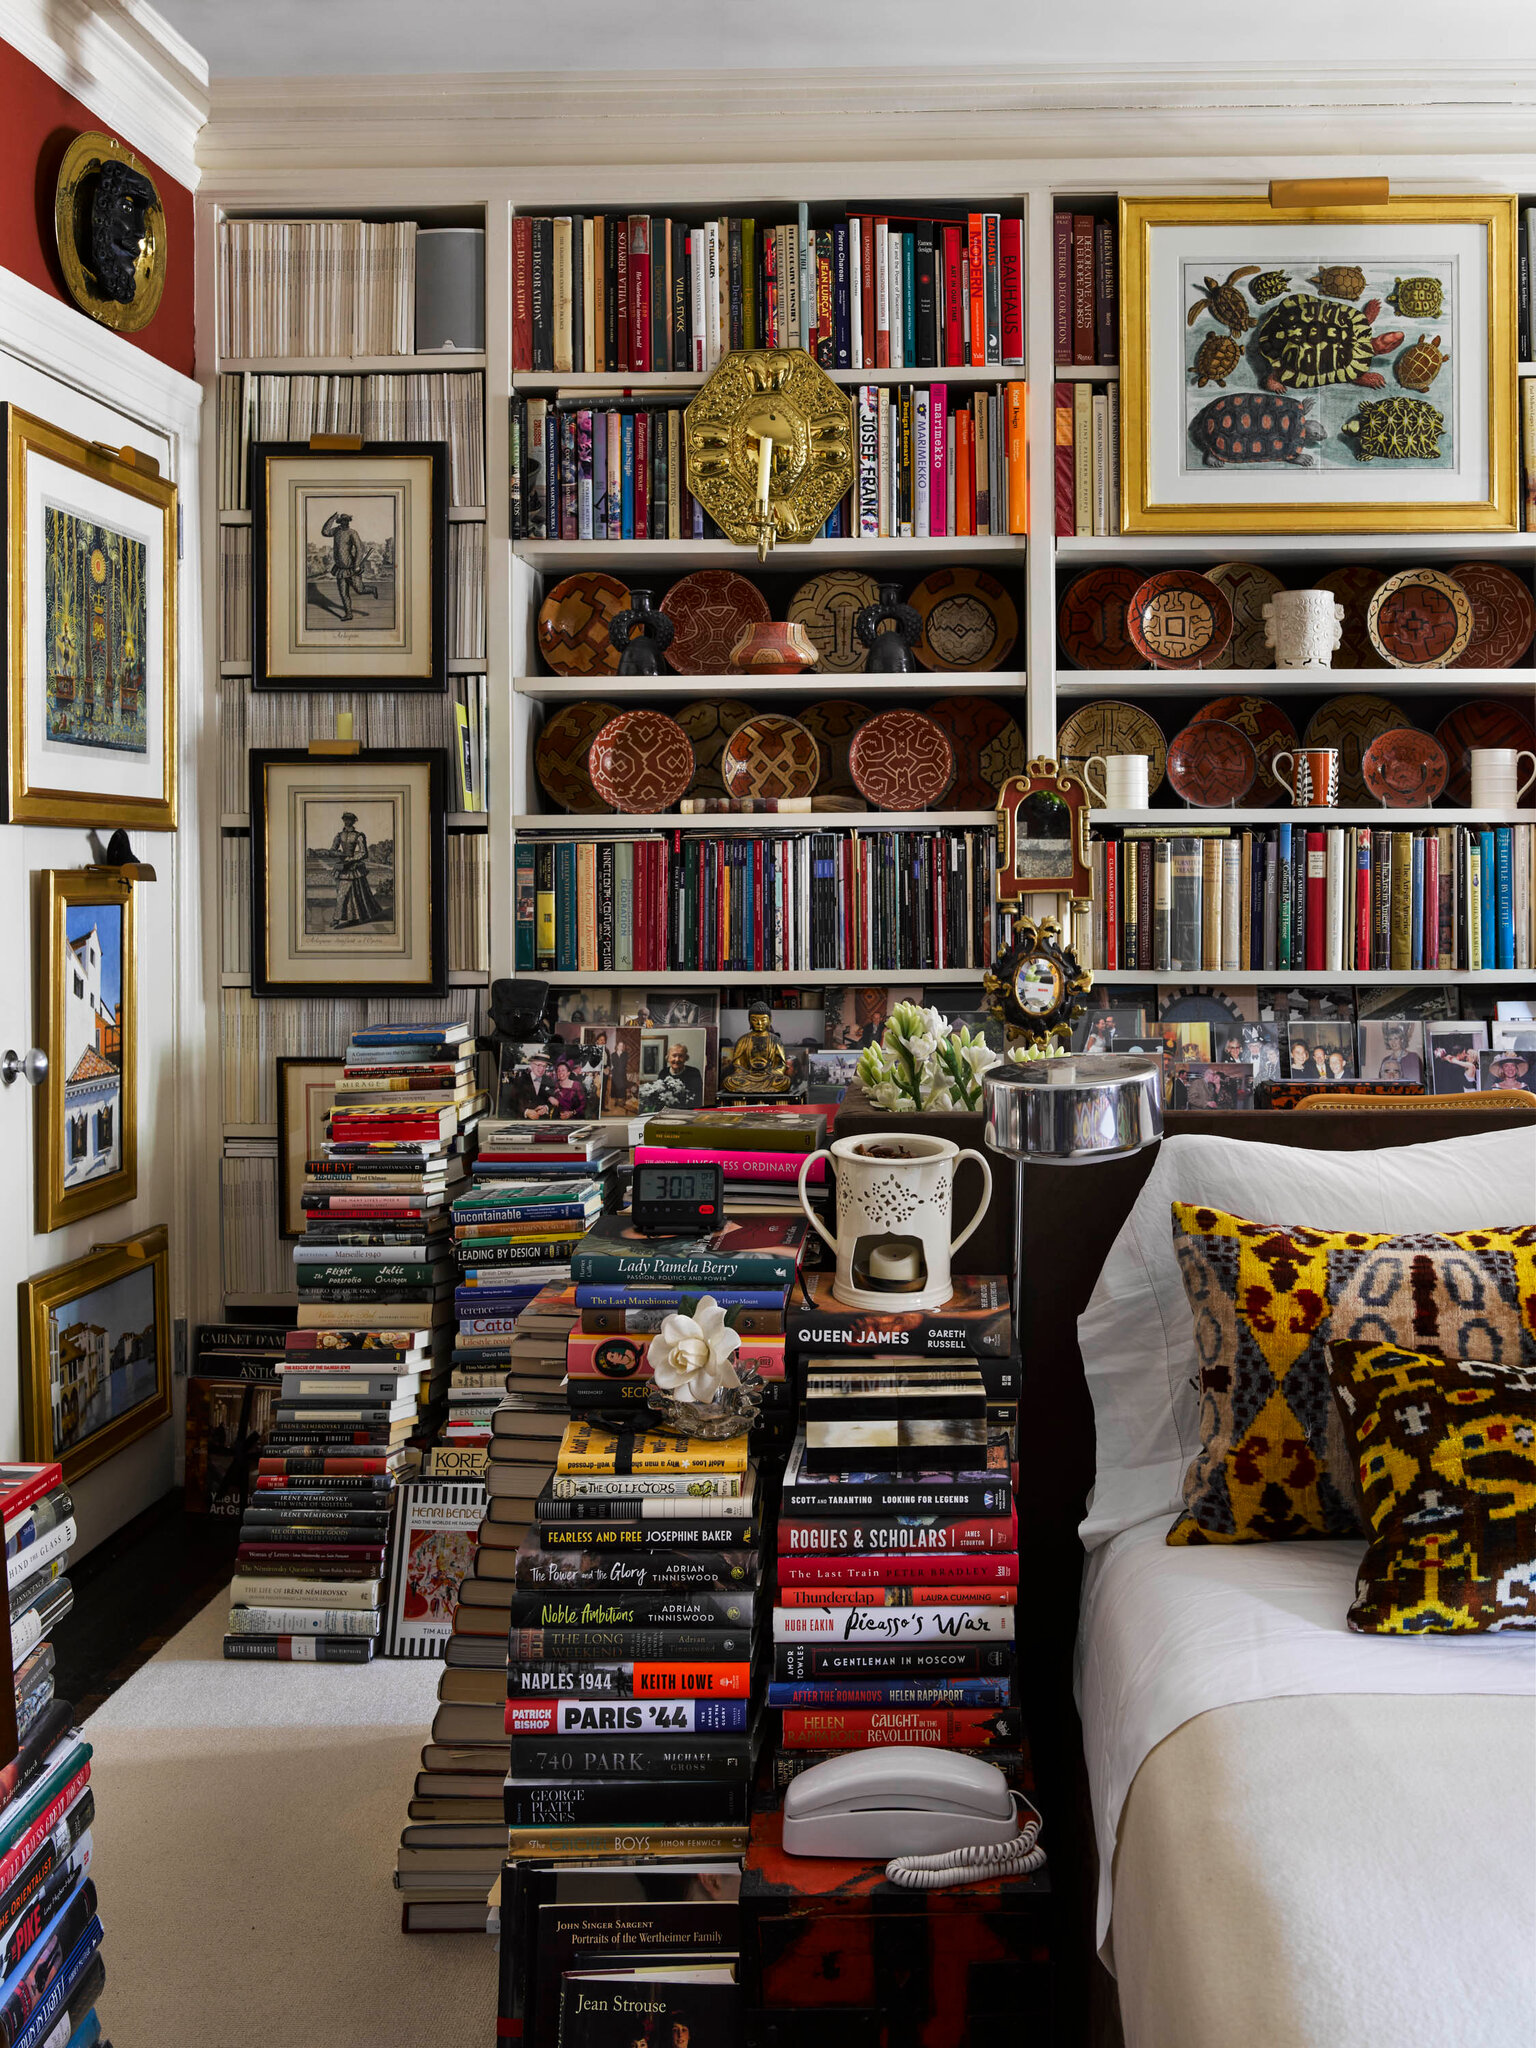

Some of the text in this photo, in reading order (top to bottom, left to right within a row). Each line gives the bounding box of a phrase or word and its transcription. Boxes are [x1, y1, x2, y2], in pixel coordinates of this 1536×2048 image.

[987, 217, 996, 266] BAUHAUS
[821, 261, 829, 283] JEAN
[517, 250, 526, 319] DECORATION
[618, 277, 626, 304] VILLA
[675, 277, 684, 303] VILLA
[1058, 233, 1067, 344] INTERIOR DECORATION
[1003, 255, 1018, 335] BAUHAUS
[619, 305, 627, 318] LA
[902, 401, 911, 467] Design Research
[934, 402, 943, 468] marimekko
[918, 420, 927, 489] MARIMEKKO
[861, 415, 876, 517] JOSEF FRANK
[1501, 849, 1509, 928] LITTLE BY LITTLE
[309, 1163, 354, 1172] THE EYE
[742, 1161, 798, 1172] ORDINARY
[454, 1209, 522, 1222] Uncontainable
[335, 1250, 382, 1259] Marseille 1940
[458, 1247, 541, 1261] LEADING BY DESIGN
[325, 1265, 404, 1276] Flight Julie
[618, 1259, 738, 1276] Lady Pamela Berry
[627, 1274, 655, 1282] PASSION,
[591, 1296, 678, 1305] The Last Marchioness
[460, 1305, 495, 1316] terence
[200, 1333, 252, 1345] CABINET
[798, 1328, 910, 1345] QUEEN JAMES
[928, 1329, 966, 1339] GARETH
[927, 1339, 966, 1349] RUSSELL
[588, 1481, 675, 1494] THE COLLECTORS
[791, 1495, 969, 1505] SCOTT TARANTINO LOOKING FOR LEGENDS
[411, 1507, 484, 1520] HENRI BENDEL
[548, 1530, 732, 1543] FEARLESS AND FREE JOSEPHINE BAKER
[790, 1529, 947, 1549] ROGUES & SCHOLARS
[964, 1530, 981, 1538] JAMES
[40, 1536, 62, 1558] GLASS
[530, 1562, 647, 1586] The Power Glory
[666, 1565, 704, 1573] ADRIAN
[789, 1567, 988, 1579] The Last Train PETER BRADLEY
[652, 1573, 718, 1582] TINNISWOOD
[793, 1591, 992, 1606] Thunderclap LAURA CUMMING
[541, 1603, 634, 1626] Noble Ambitions
[662, 1605, 700, 1613] ADRIAN
[648, 1614, 715, 1623] TINNISWOOD
[784, 1619, 808, 1632] HUGH
[809, 1619, 834, 1632] EAKIN
[932, 1613, 992, 1637] War
[552, 1633, 580, 1645] THE
[584, 1633, 624, 1645] LONG
[552, 1646, 623, 1658] WEEKEND
[822, 1655, 966, 1667] A GENTLEMAN IN MOSCOW
[521, 1672, 714, 1691] NAPLES 1944 KEITH LOWE
[793, 1690, 964, 1702] AFTER THE ROMANOVS HELEN RAPPAPORT
[512, 1709, 552, 1720] PATRICK
[564, 1706, 643, 1730] PARIS
[871, 1713, 920, 1728] CAUGHT
[514, 1720, 550, 1730] BISHOP
[804, 1716, 845, 1729] HELEN
[787, 1730, 865, 1742] RAPPAPORT
[867, 1729, 941, 1742] REVOLUTION
[537, 1752, 644, 1771] 740 PARK
[664, 1752, 713, 1762] MICHAEL
[670, 1763, 706, 1771] GROSS
[530, 1789, 585, 1801] GEORGE
[531, 1801, 575, 1813] PLATT
[531, 1812, 576, 1823] LYNES
[529, 1840, 546, 1850] The
[614, 1836, 650, 1851] BOYS
[660, 1840, 686, 1848] SIMON
[688, 1838, 722, 1848] FENWICK
[15, 1904, 41, 1961] PIKE
[571, 1931, 723, 1945] Portraits of the Wertheimer Family
[575, 1993, 667, 2015] Jean Strouse
